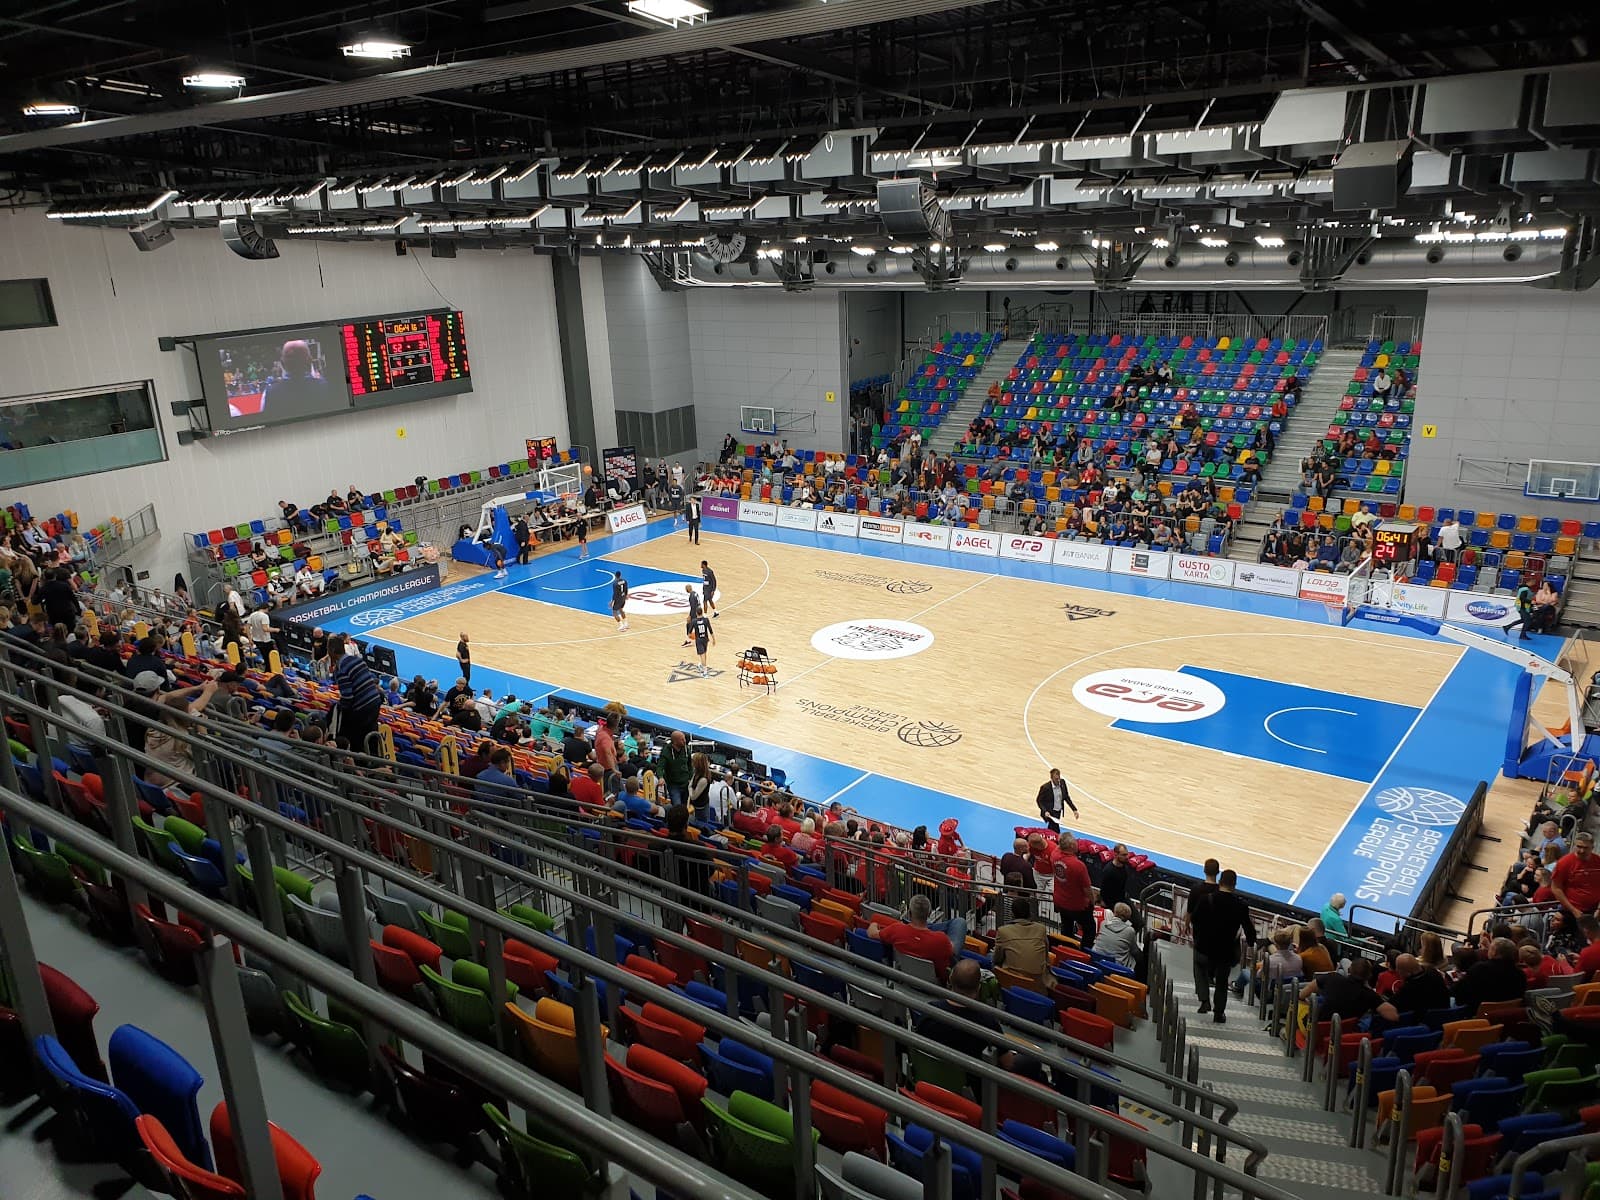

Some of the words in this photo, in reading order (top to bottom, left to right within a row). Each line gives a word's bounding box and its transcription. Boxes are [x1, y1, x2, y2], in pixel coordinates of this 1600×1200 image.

[392, 344, 402, 352] 52
[620, 512, 642, 525] AGEL
[963, 536, 992, 549] AGEL
[1376, 531, 1407, 543] 06:41
[1011, 539, 1043, 552] era
[1376, 545, 1395, 558] 24
[1074, 552, 1100, 561] BANKA
[1178, 560, 1210, 571] GUSTO
[1184, 570, 1209, 580] KARTA
[288, 602, 346, 623] BASKETBALL
[348, 587, 399, 608] CHAMPIONS
[400, 577, 432, 592] LEAGUE
[1120, 678, 1152, 688] RADAR
[1086, 683, 1205, 712] era
[796, 698, 899, 727] CHAMPIONS
[848, 704, 908, 722] LEAGUE
[800, 707, 890, 733] BASKETBALL
[1353, 817, 1394, 859] LEAGUE
[1355, 824, 1418, 902] CHAMPIONS
[1388, 829, 1442, 896] BASKETBALL
